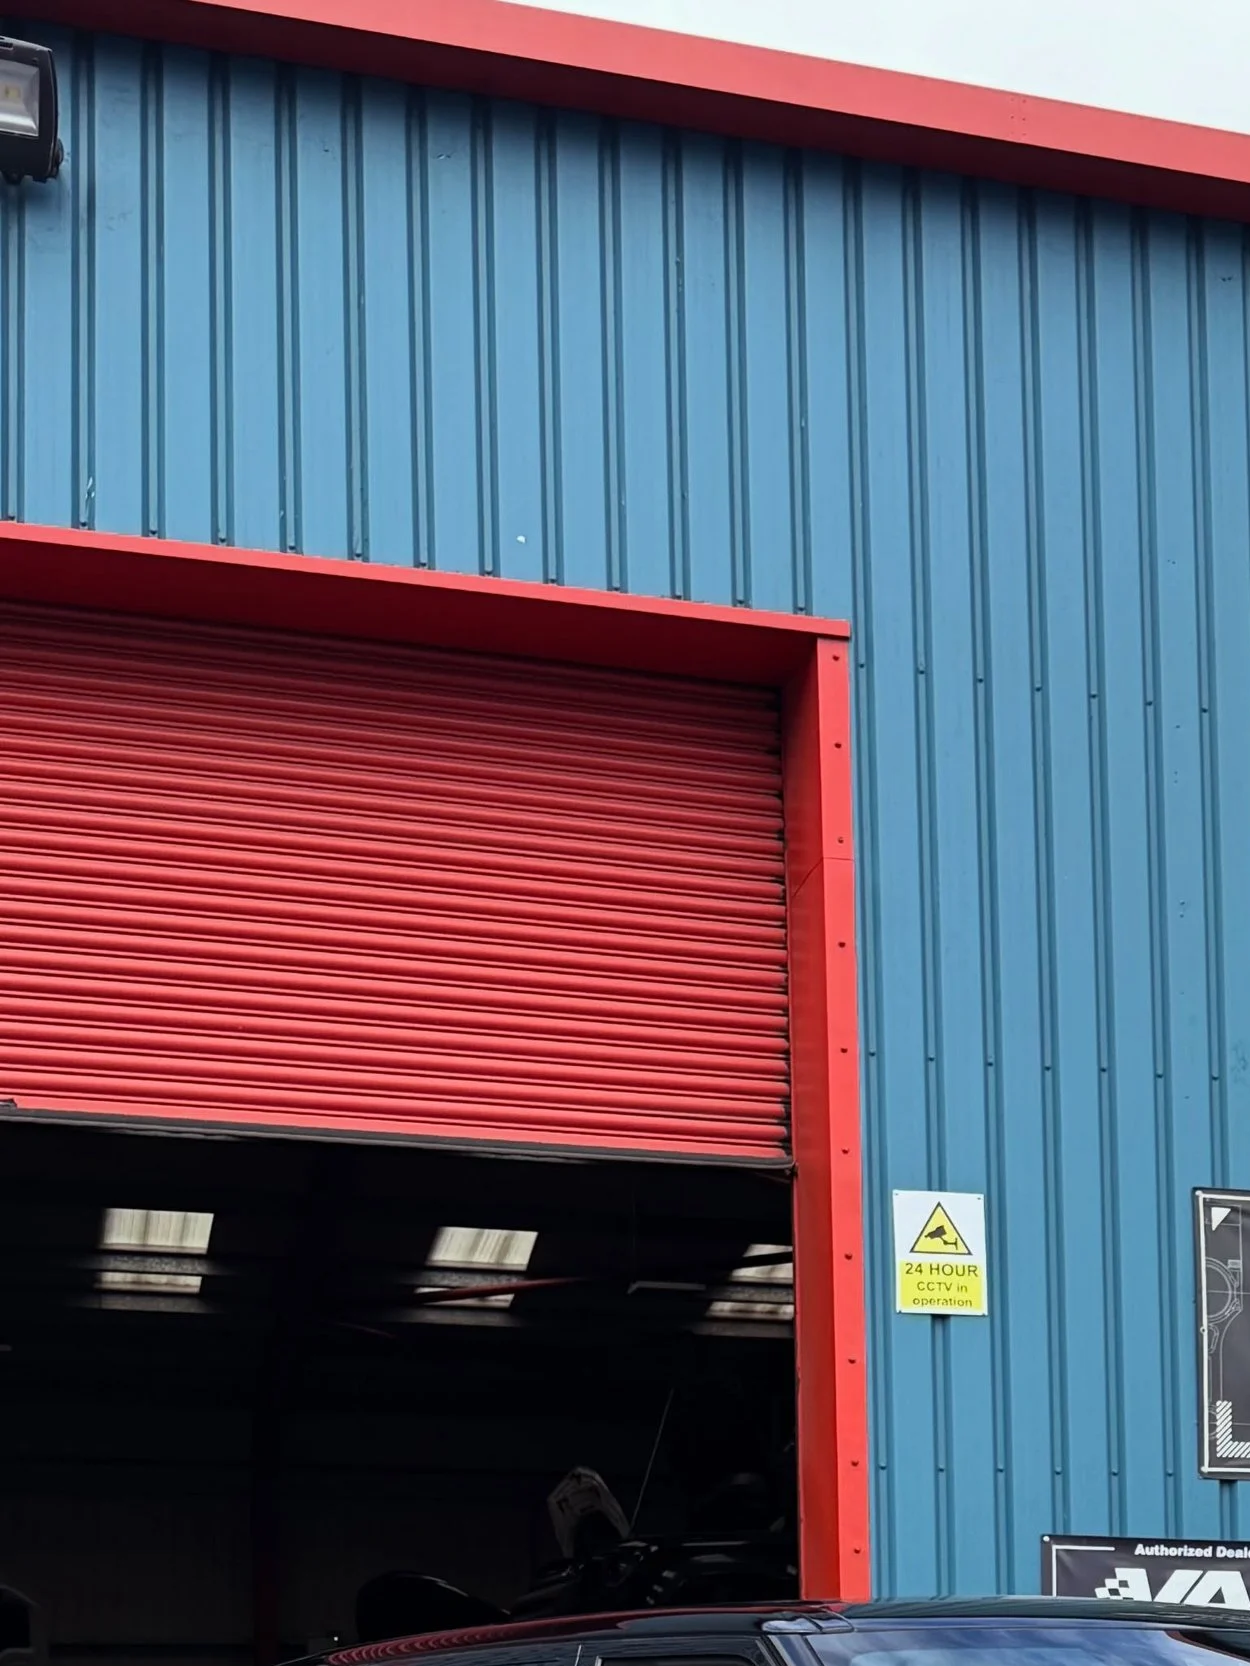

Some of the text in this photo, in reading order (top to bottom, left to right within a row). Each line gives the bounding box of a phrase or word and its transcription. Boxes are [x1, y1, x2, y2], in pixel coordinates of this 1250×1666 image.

[904, 1262, 979, 1277] 24 HOUR
[916, 1281, 968, 1293] CCTV in
[912, 1297, 973, 1308] operation
[1134, 1543, 1213, 1558] Authorized
